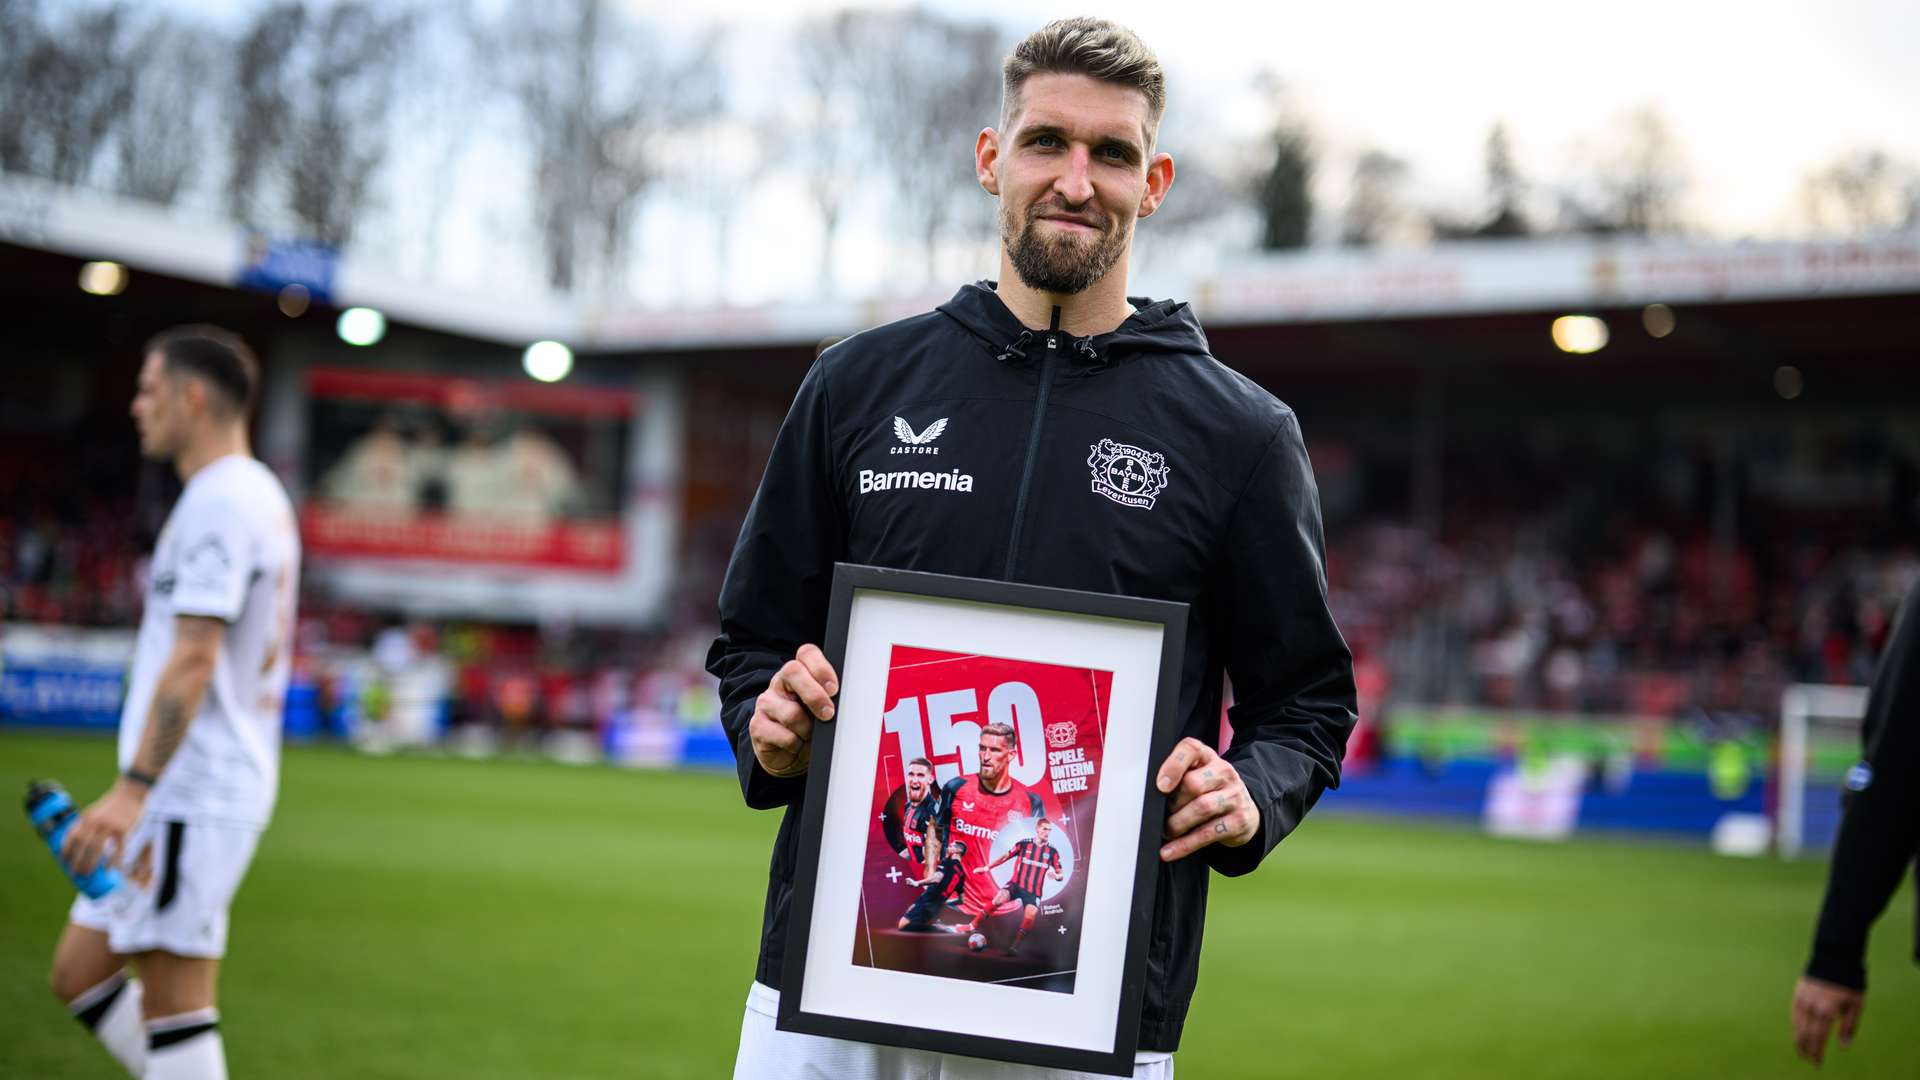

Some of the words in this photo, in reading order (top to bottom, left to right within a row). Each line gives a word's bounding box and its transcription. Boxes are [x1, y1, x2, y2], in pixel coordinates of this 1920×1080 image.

[890, 446, 939, 455] CASTORE
[1122, 448, 1142, 458] 1904
[859, 468, 974, 494] Barmenia
[1110, 467, 1145, 483] BAYER
[1122, 459, 1134, 491] BAYER
[1096, 483, 1149, 506] Leverkusen
[883, 681, 1047, 797] 150
[1048, 748, 1085, 766] SPIELE
[1050, 760, 1095, 780] UNTERM
[1052, 776, 1088, 794] KREUZ
